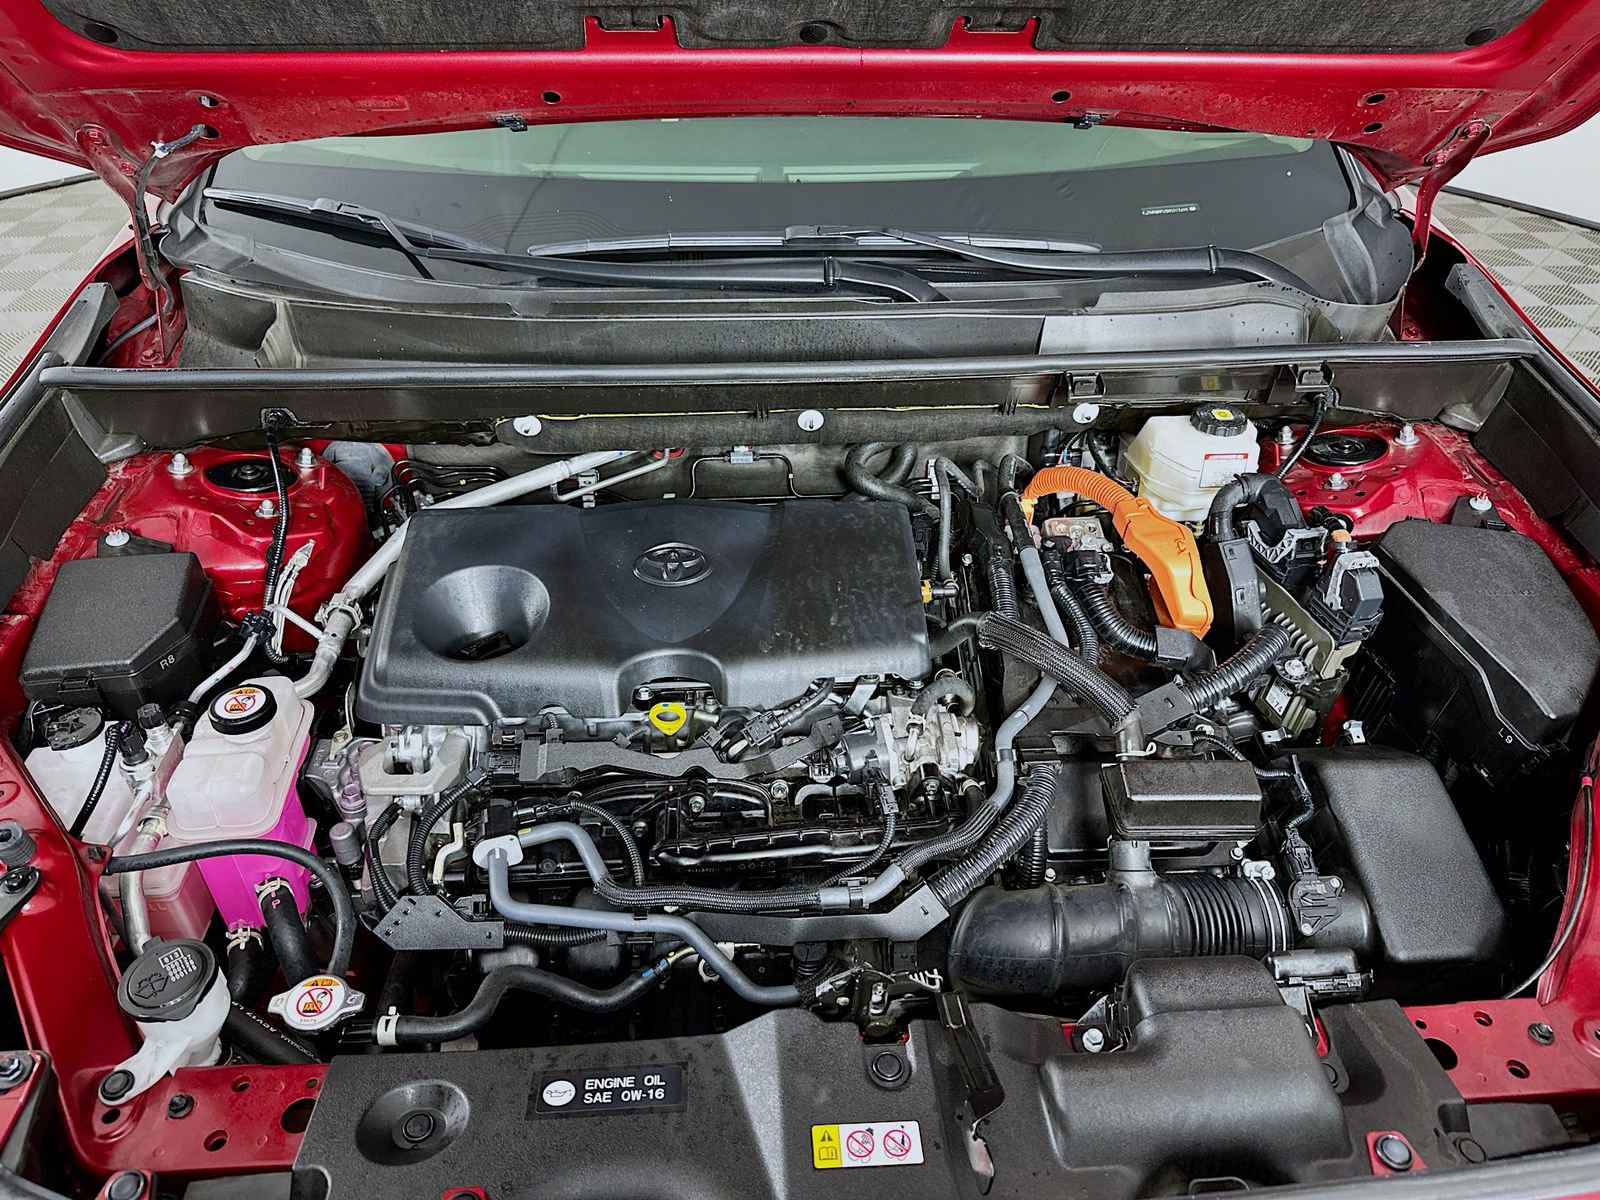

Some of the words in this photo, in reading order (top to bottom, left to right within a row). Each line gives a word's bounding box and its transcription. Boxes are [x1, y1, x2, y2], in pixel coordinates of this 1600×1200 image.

[160, 654, 175, 670] R8
[1498, 727, 1513, 744] L9
[280, 1033, 315, 1059] YOKOHAMA
[584, 1076, 636, 1091] ENGINE
[643, 1074, 666, 1087] OIL
[583, 1091, 613, 1104] SAE
[620, 1087, 666, 1102] 0W-16
